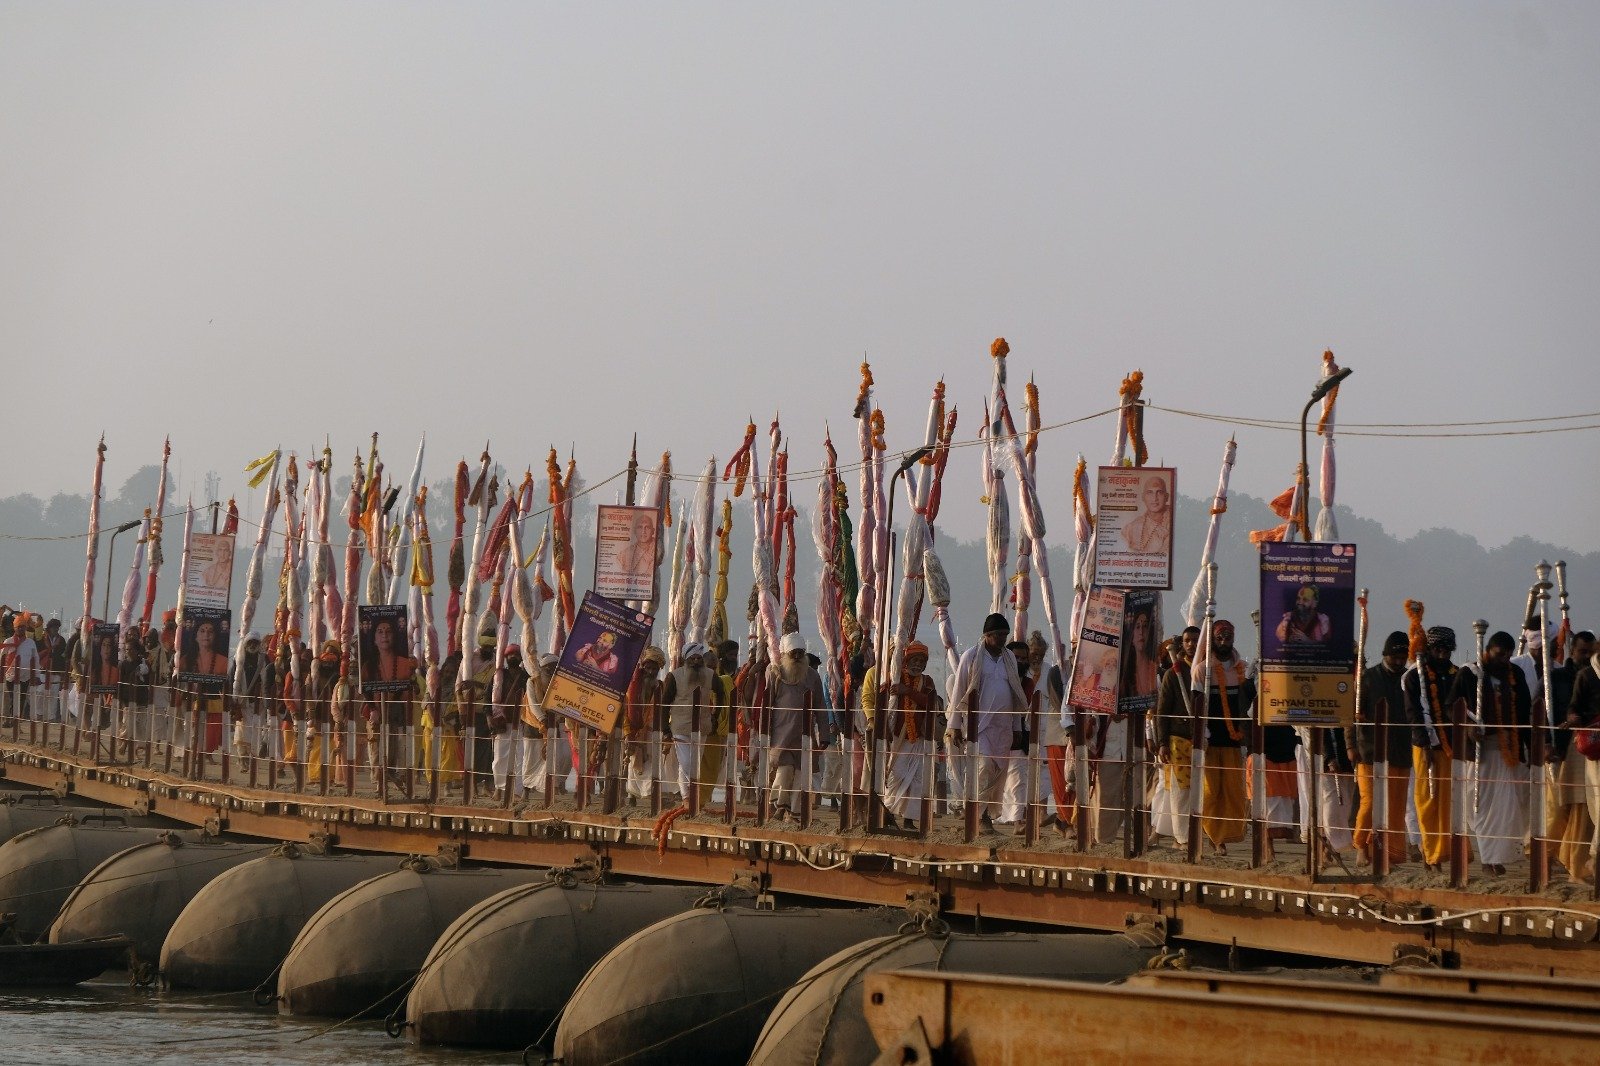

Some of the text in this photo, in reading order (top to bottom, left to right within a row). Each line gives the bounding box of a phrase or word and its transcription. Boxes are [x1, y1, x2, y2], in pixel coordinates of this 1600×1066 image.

[554, 694, 580, 709] SHYAM
[581, 707, 606, 720] STEEL
[1270, 698, 1340, 707] SHYAM STEEL
